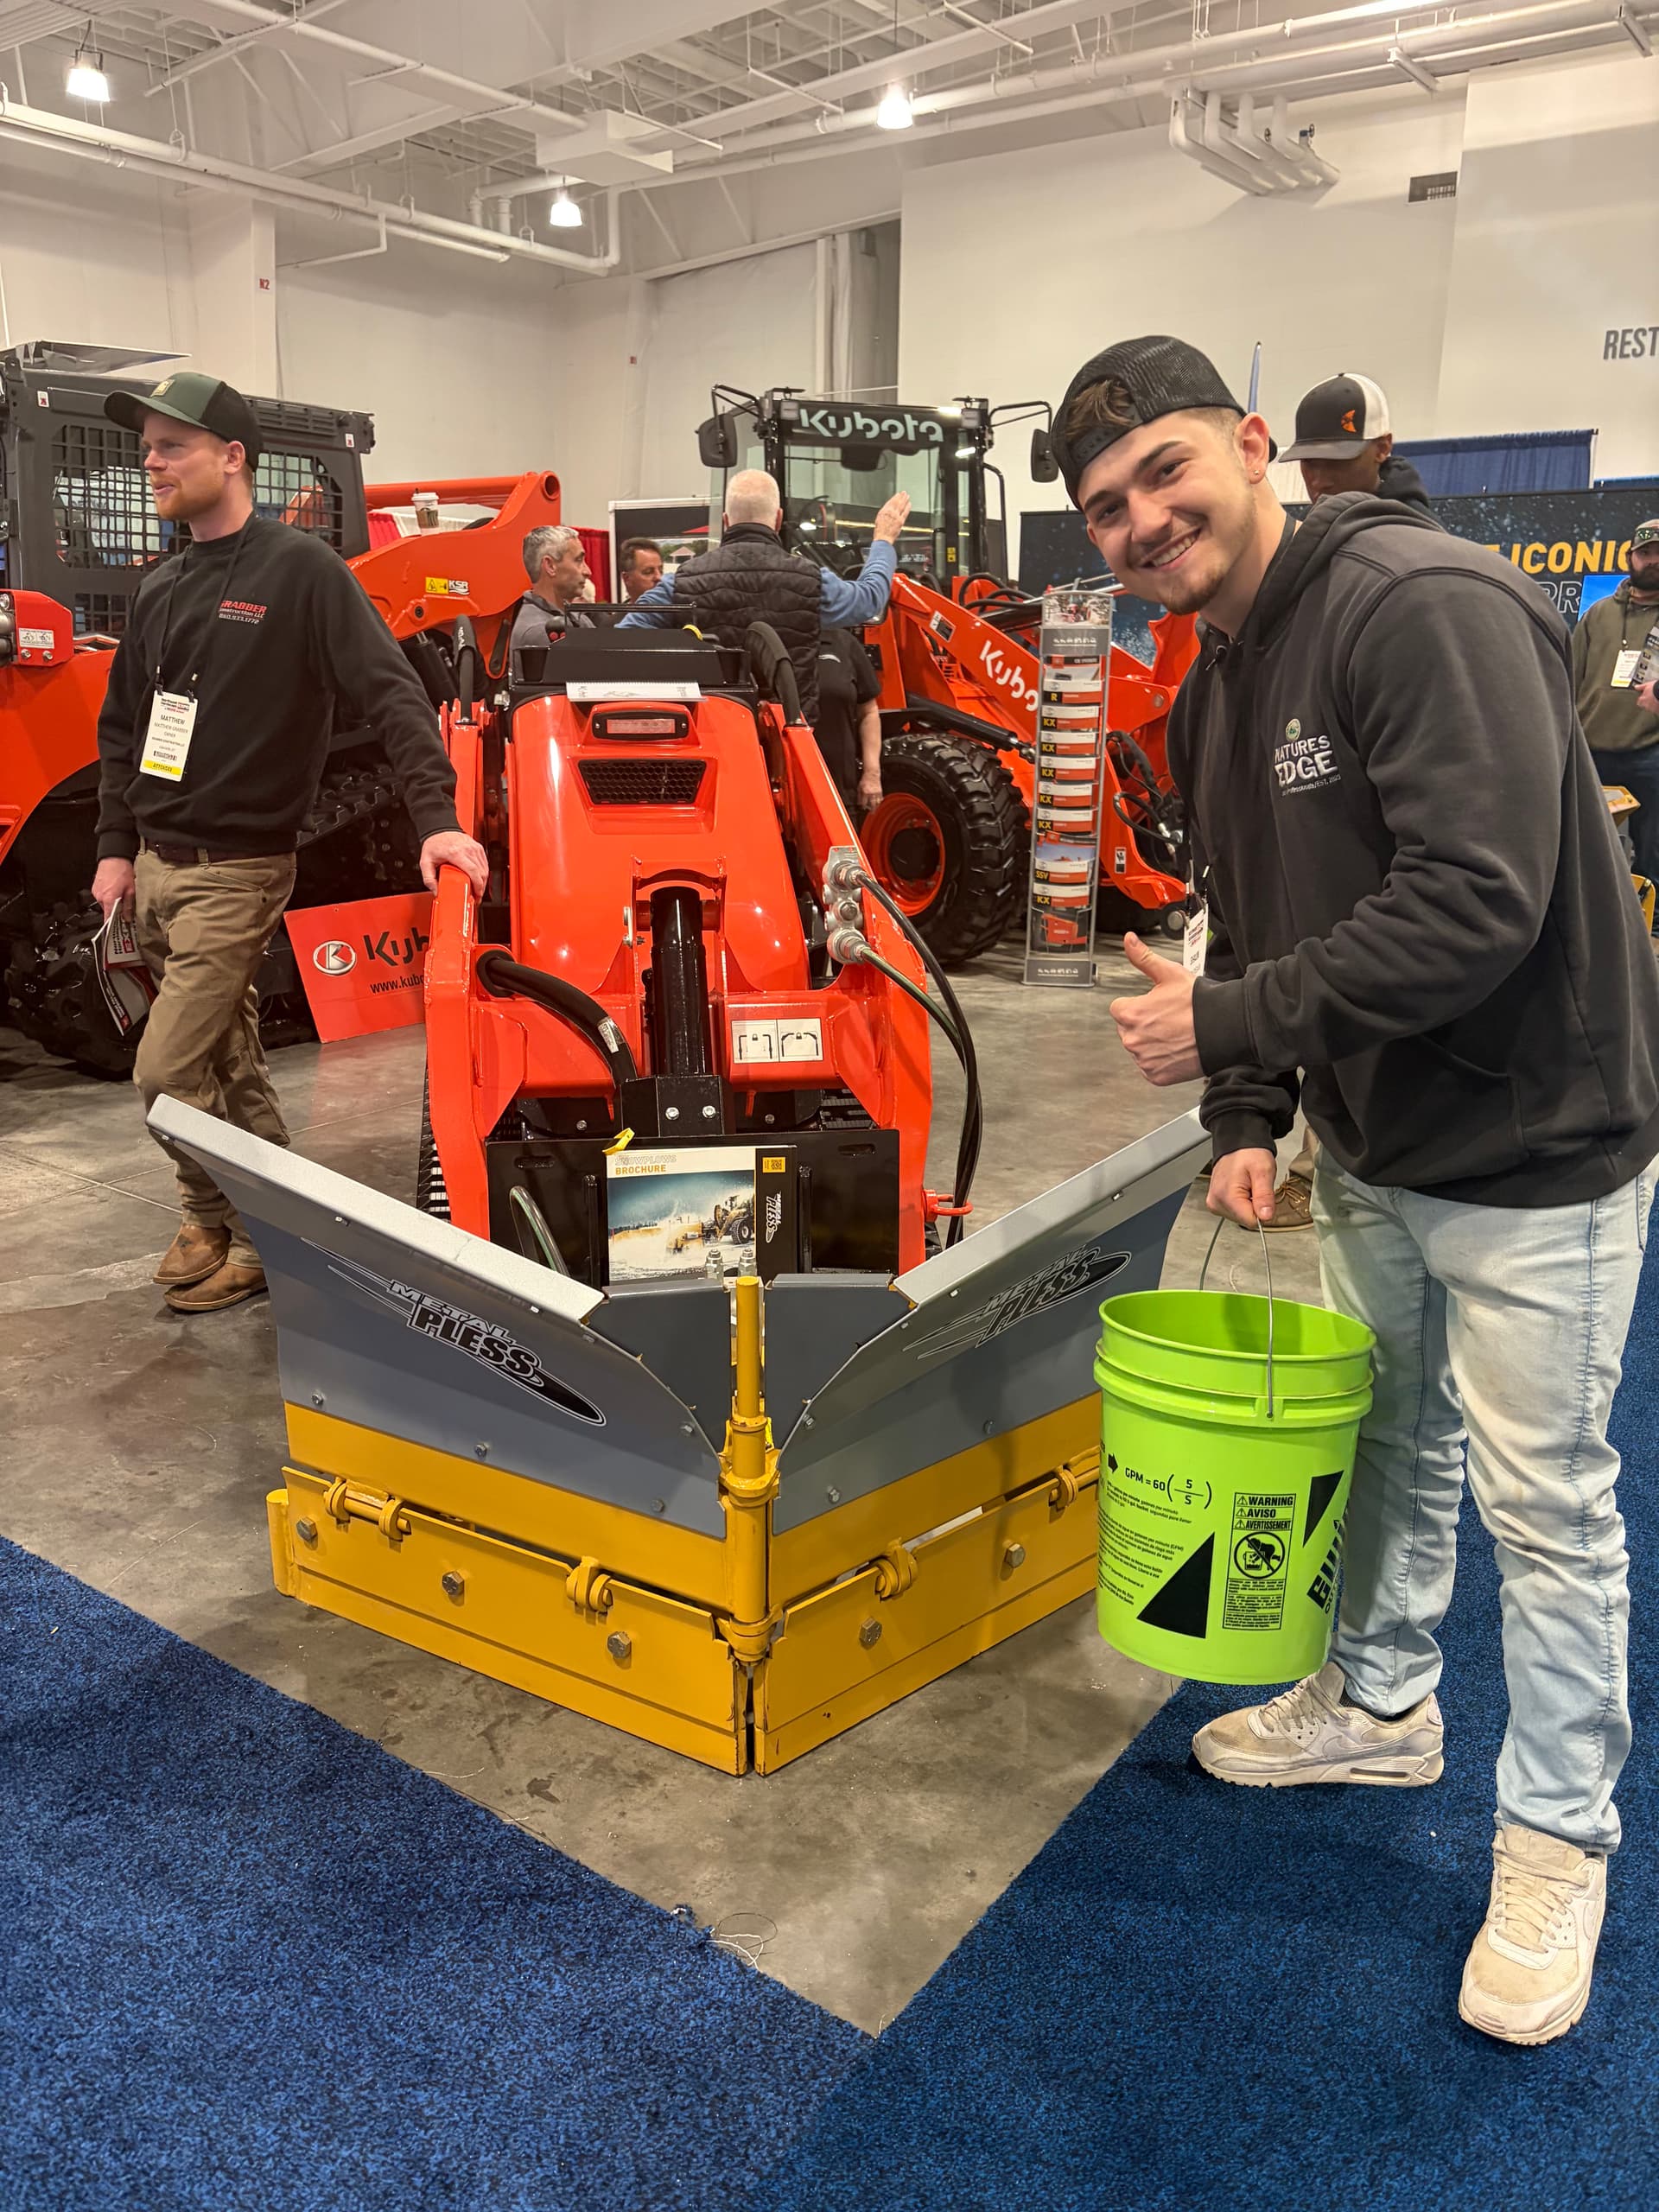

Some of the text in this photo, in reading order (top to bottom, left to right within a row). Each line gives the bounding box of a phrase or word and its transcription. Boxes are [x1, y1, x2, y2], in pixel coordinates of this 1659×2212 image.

[799, 408, 944, 442] Kubota
[1051, 692, 1058, 702] R
[161, 715, 185, 726] MATTHEW
[1044, 717, 1056, 727] KX
[1042, 743, 1054, 753] KX
[1274, 735, 1331, 764] NATURES
[1041, 768, 1054, 778] KX
[1274, 750, 1338, 787] EDGE
[1039, 794, 1052, 804] KX
[1039, 820, 1051, 830] KX
[1037, 895, 1050, 905] KX
[615, 1164, 667, 1175] BROCHURE
[766, 1196, 778, 1232] PLESS
[982, 1244, 1088, 1317] METAL
[976, 1247, 1101, 1348] PLESS
[391, 1280, 515, 1344] METAL
[409, 1302, 542, 1380] PLESS
[1125, 1467, 1144, 1484] GPM
[1249, 1496, 1294, 1506] WARNING
[1247, 1508, 1276, 1518] AVISO
[1245, 1520, 1292, 1529] AVERTISSEMENT
